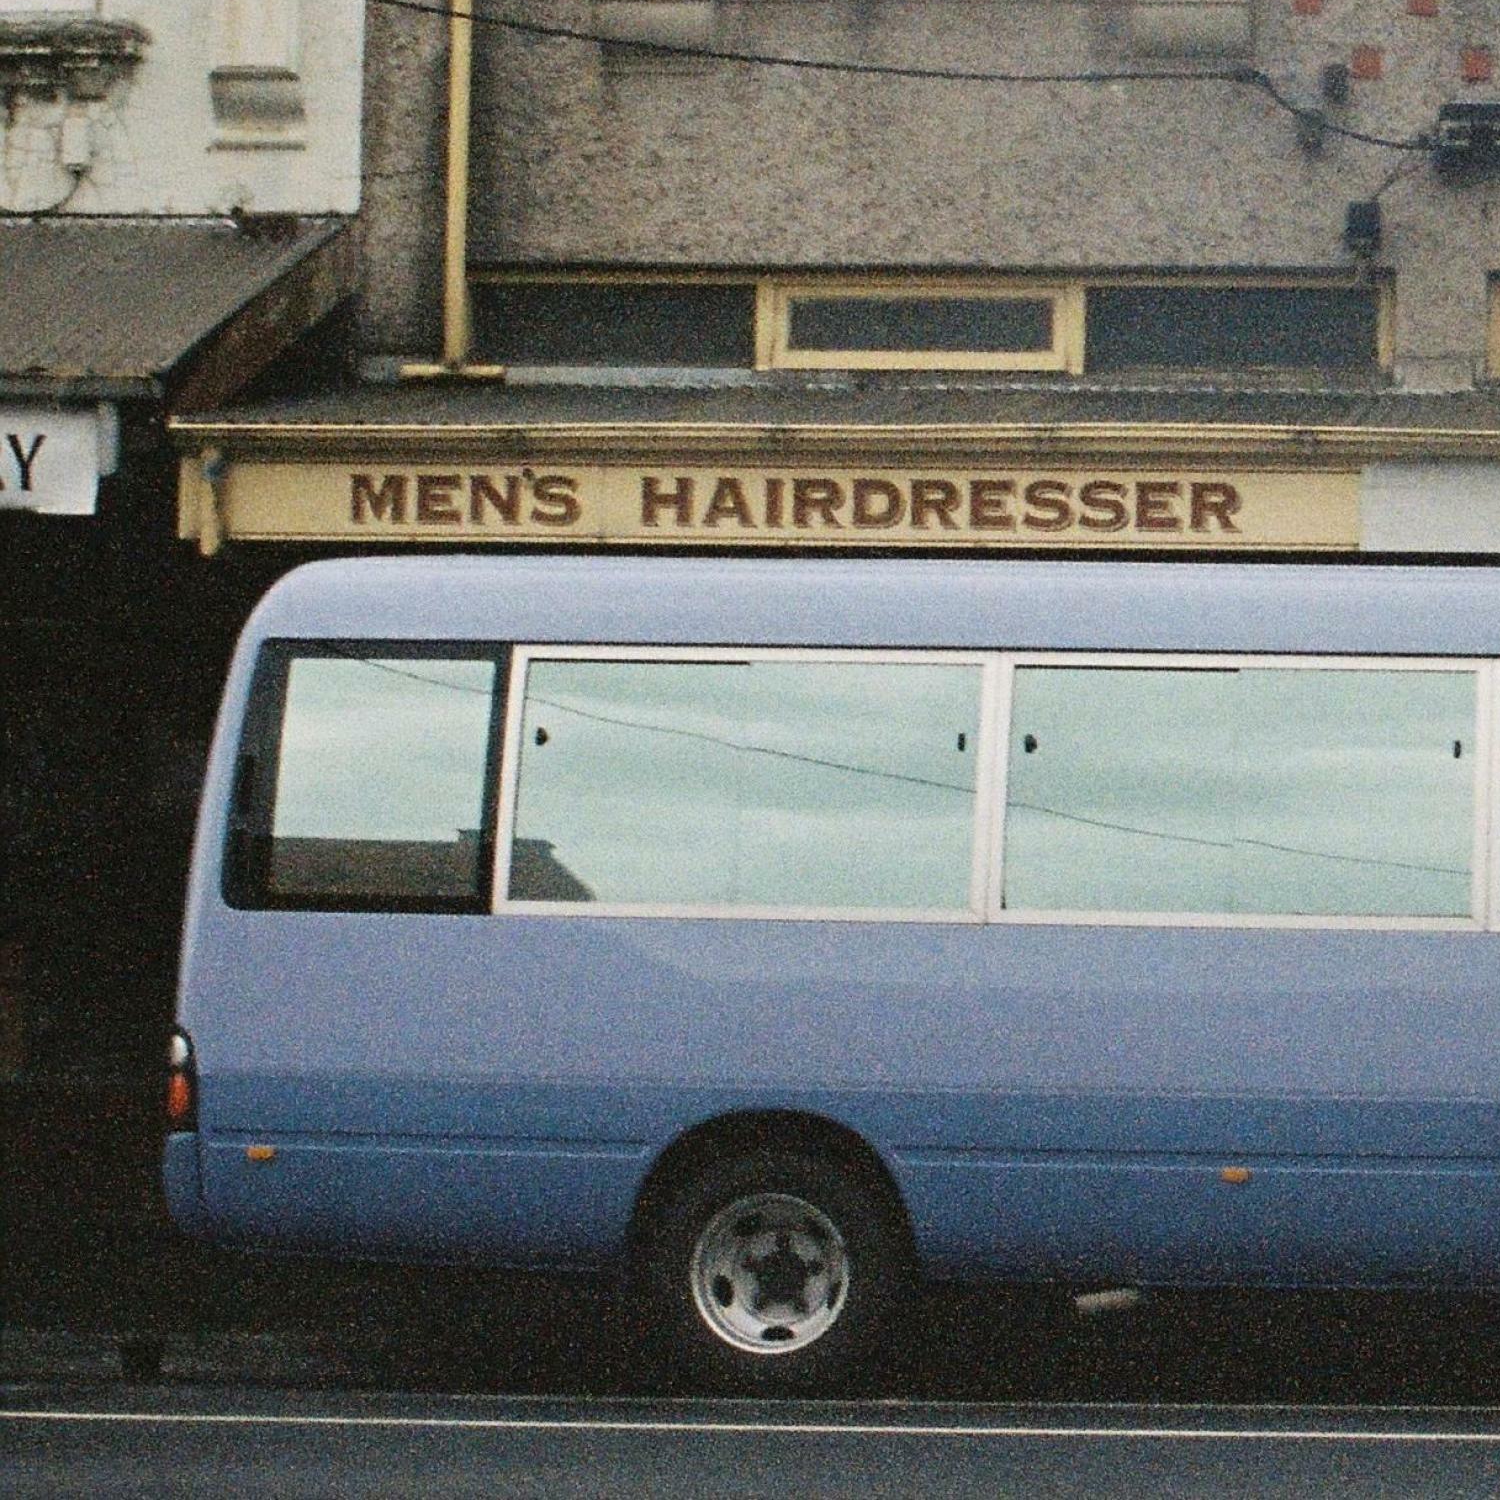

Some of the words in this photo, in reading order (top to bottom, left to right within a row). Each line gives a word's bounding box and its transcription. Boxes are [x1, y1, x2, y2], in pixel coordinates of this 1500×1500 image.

[0, 434, 47, 491] Y
[350, 468, 583, 527] MEN'S
[640, 476, 1243, 534] HAIRDRESSER
